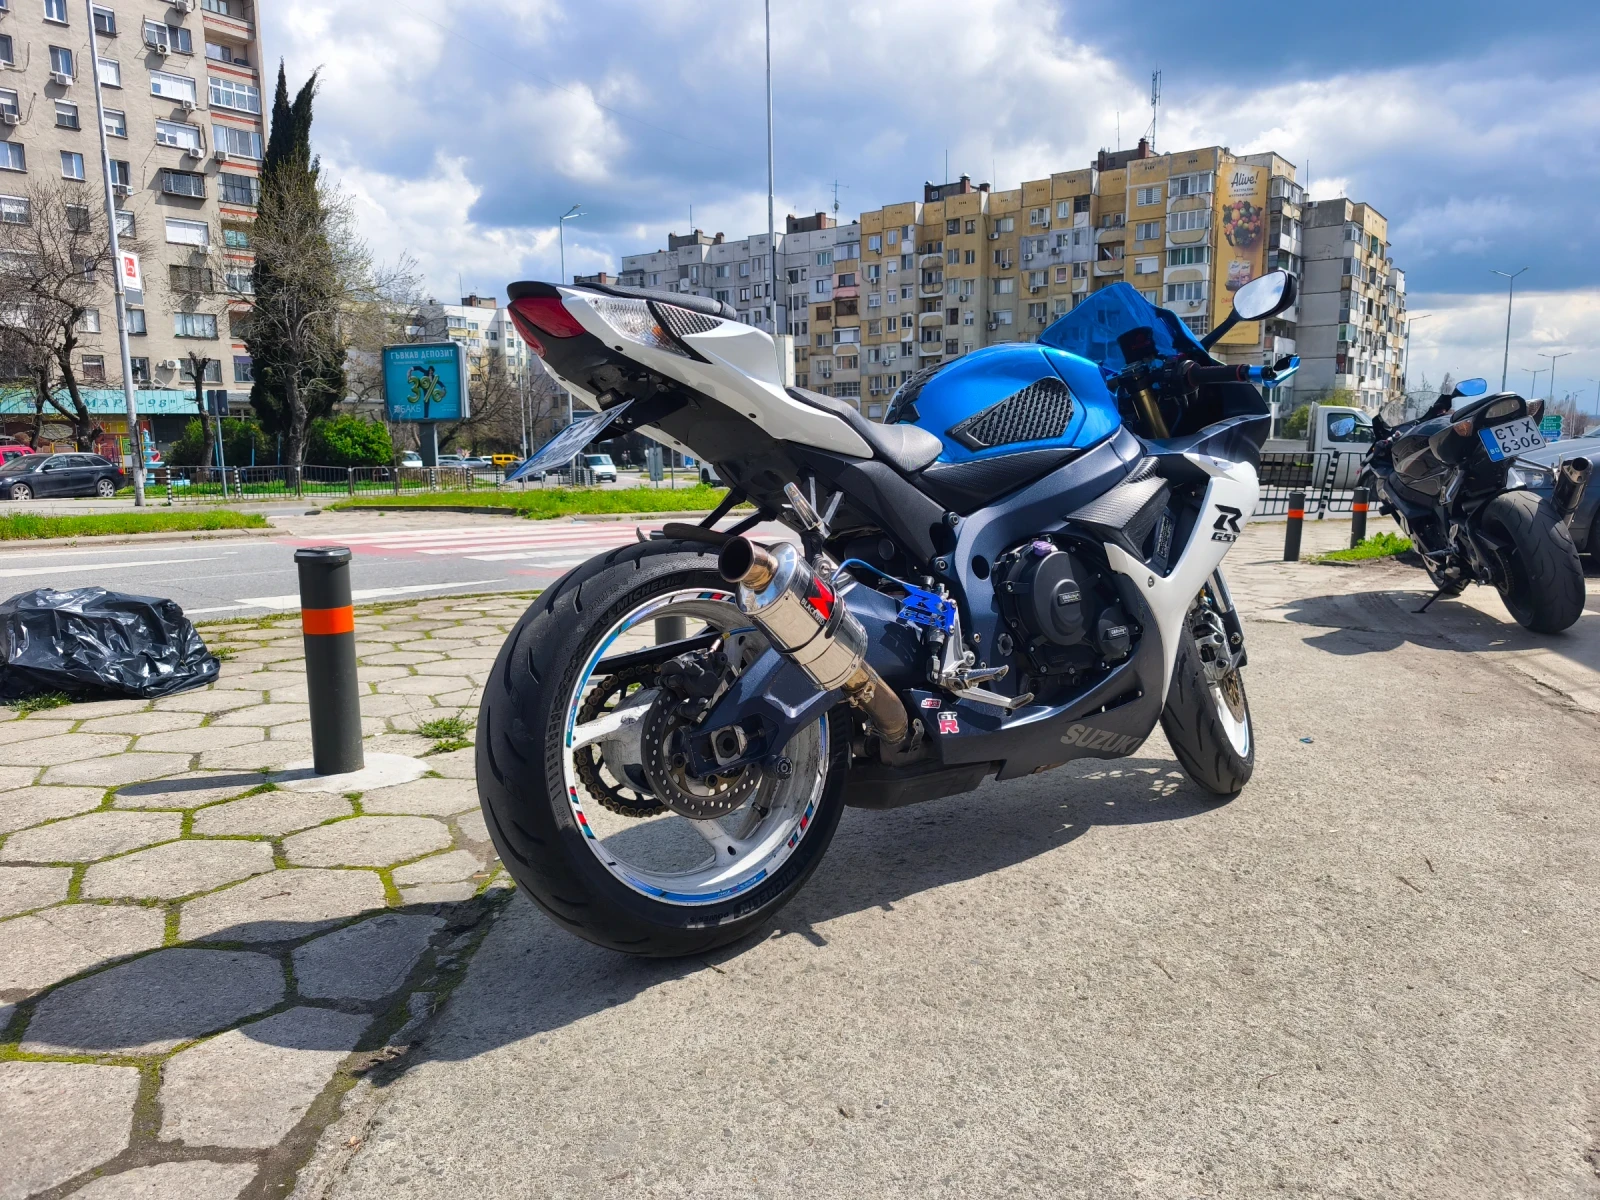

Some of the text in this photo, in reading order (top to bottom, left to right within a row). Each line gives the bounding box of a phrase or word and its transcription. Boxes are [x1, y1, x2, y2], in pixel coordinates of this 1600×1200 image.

[1231, 170, 1260, 188] Alive!
[390, 349, 454, 360] ГЪВКАВ ДЕПОЗИТ
[407, 375, 447, 404] 3%
[1502, 434, 1541, 453] 6306
[1060, 724, 1143, 754] SUZUKI
